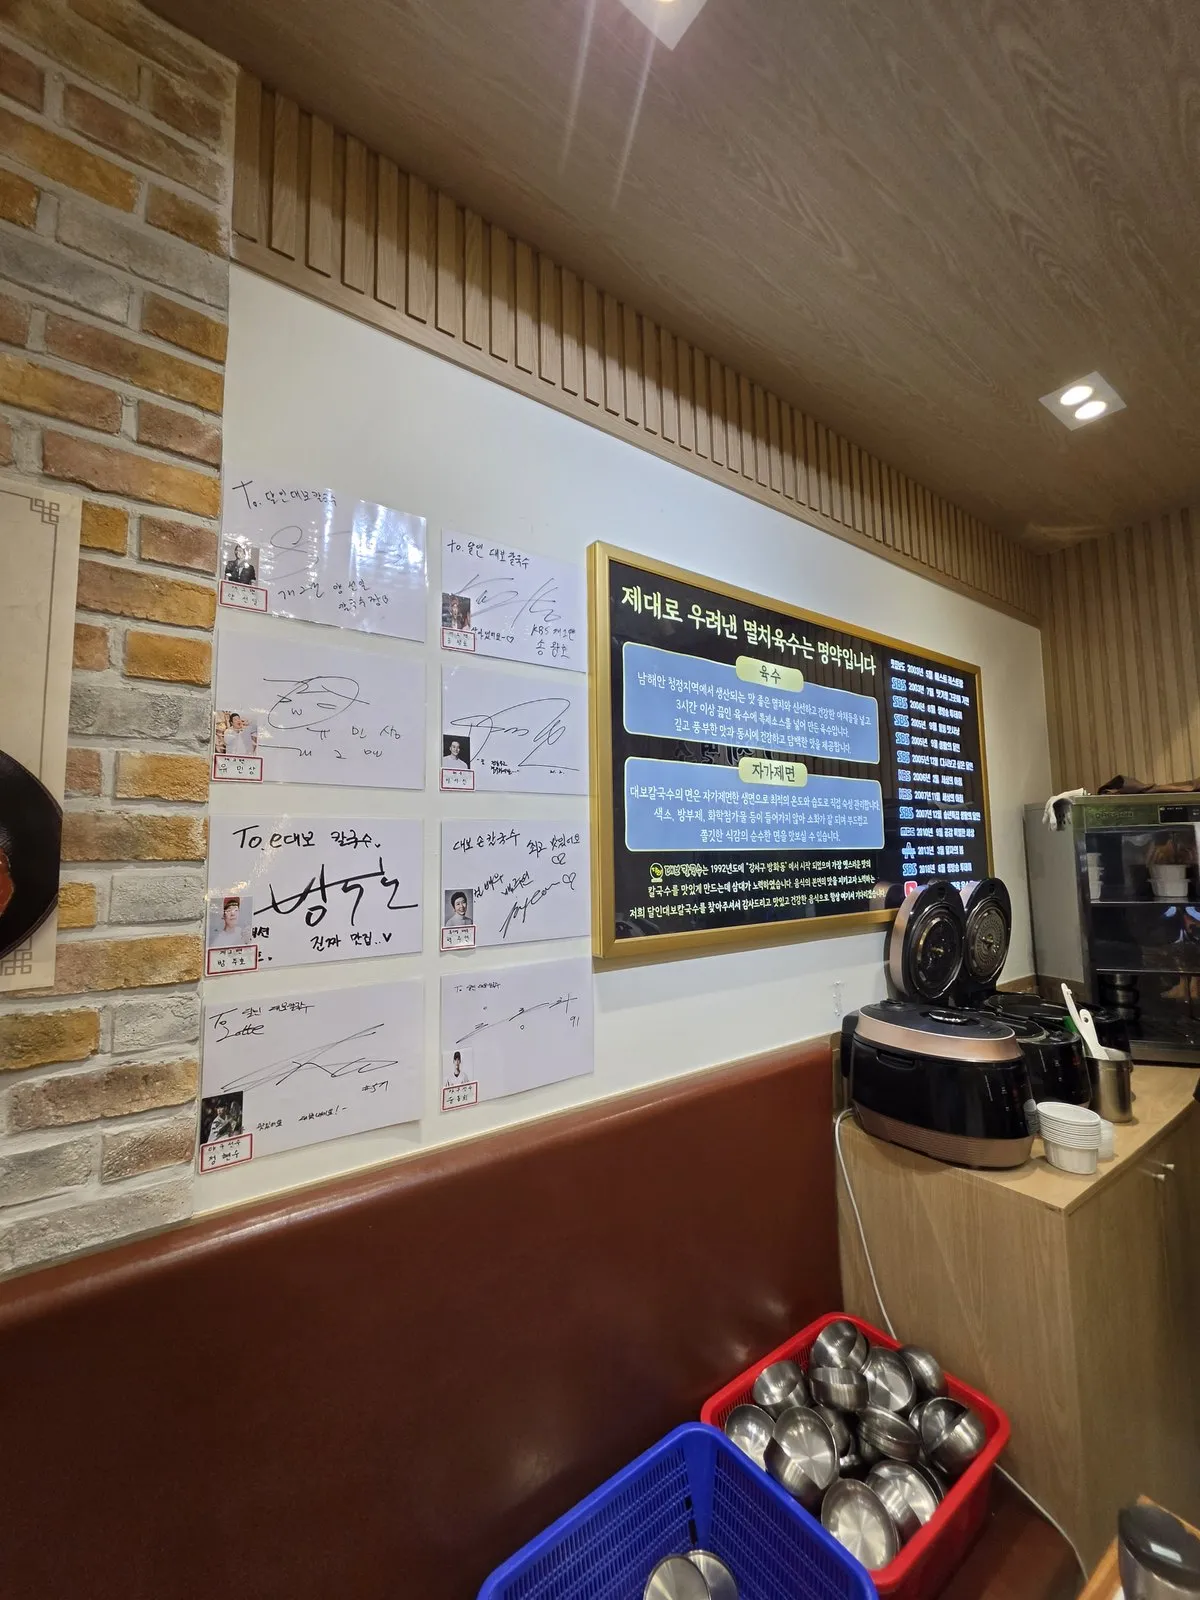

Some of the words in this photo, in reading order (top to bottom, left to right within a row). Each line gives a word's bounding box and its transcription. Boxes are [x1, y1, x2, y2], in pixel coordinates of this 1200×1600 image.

[232, 480, 261, 509] To.
[531, 624, 550, 636] KBS
[621, 585, 683, 622] 제대로
[688, 604, 737, 639] 우려낸
[744, 620, 815, 660] 멸치육수는
[818, 641, 876, 676] 명약입니다
[760, 665, 781, 684] 육수
[892, 677, 907, 691] SBS
[637, 672, 666, 689] 남해안
[668, 677, 714, 697] 청정지역에서
[716, 686, 746, 703] 생산되는
[748, 693, 755, 704] 맛
[757, 695, 770, 708] 좋은
[772, 698, 791, 712] 멸치와
[793, 702, 817, 715] 신선하고
[818, 707, 835, 719] 건강한
[893, 695, 908, 709] SBS
[676, 699, 697, 714] 3시간
[700, 703, 715, 716] 이상
[717, 706, 731, 719] 끓인
[734, 709, 757, 723] 육수에
[759, 712, 791, 729] 특제소스를
[794, 719, 806, 730] 넣어
[808, 721, 819, 733] 만든
[820, 724, 849, 738] 육수입니다.
[894, 714, 909, 727] SBS
[675, 717, 690, 731] 깊고
[692, 721, 718, 736] 풍부한
[720, 725, 734, 738] 맛과
[736, 728, 758, 741] 동시에
[760, 730, 786, 744] 건강하고
[787, 735, 808, 748] 담백한
[809, 737, 820, 750] 맛을
[895, 732, 910, 745] SBS
[897, 750, 910, 764] SBS
[752, 763, 795, 783] 자가제면
[630, 785, 683, 801] 대보칼국수의
[685, 788, 701, 802] 면은
[703, 789, 739, 804] 자가제면한
[741, 792, 769, 805] 생면으로
[770, 794, 789, 806] 최적의
[791, 795, 810, 807] 온도와
[811, 796, 829, 808] 습도로
[831, 797, 841, 809] 직접
[842, 798, 853, 810] 숙성
[914, 791, 932, 801] 2007년
[654, 807, 675, 821] 색소,
[677, 808, 705, 822] 방부제,
[708, 809, 747, 823] 화학첨가물
[749, 810, 763, 824] 등이
[764, 812, 791, 824] 들어가지
[792, 812, 805, 824] 않아
[807, 813, 825, 825] 소화가
[827, 814, 833, 825] 잘
[834, 814, 846, 825] 되며
[847, 815, 869, 827] 부드럽고
[900, 807, 914, 819] SBS
[916, 810, 933, 819] 2007년
[233, 825, 264, 850] To.
[700, 829, 724, 842] 쫄깃한
[726, 829, 748, 842] 식감의
[750, 829, 771, 842] 순수한
[773, 829, 787, 842] 면을
[789, 830, 807, 842] 맛보실
[809, 831, 815, 842] 수
[816, 830, 840, 842] 있습니다.
[453, 838, 473, 852] 대보
[711, 863, 745, 875] 1992년도에
[789, 861, 799, 872] 에서
[800, 860, 811, 871] 시작
[812, 860, 831, 870] 되었으며
[832, 859, 842, 870] 가장
[862, 859, 871, 869] 맛의
[903, 863, 918, 876] SBS
[648, 885, 679, 897] 칼국수를
[681, 883, 702, 896] 맛있게
[704, 881, 731, 894] 만드는데
[732, 880, 752, 893] 삼대가
[794, 877, 811, 889] 음식의
[827, 876, 838, 886] 맛을
[838, 875, 858, 886] 지키고자
[630, 906, 645, 919] 저희
[647, 902, 706, 918] 달인대보칼국수를
[708, 899, 742, 914] 찾아주셔서
[742, 898, 772, 910] 감사드리고
[773, 896, 790, 908] 맛있고
[791, 895, 808, 906] 건강한
[809, 893, 830, 905] 음식으로
[841, 891, 855, 902] 여기서
[310, 935, 342, 951] 진짜
[570, 1016, 579, 1027] 91
